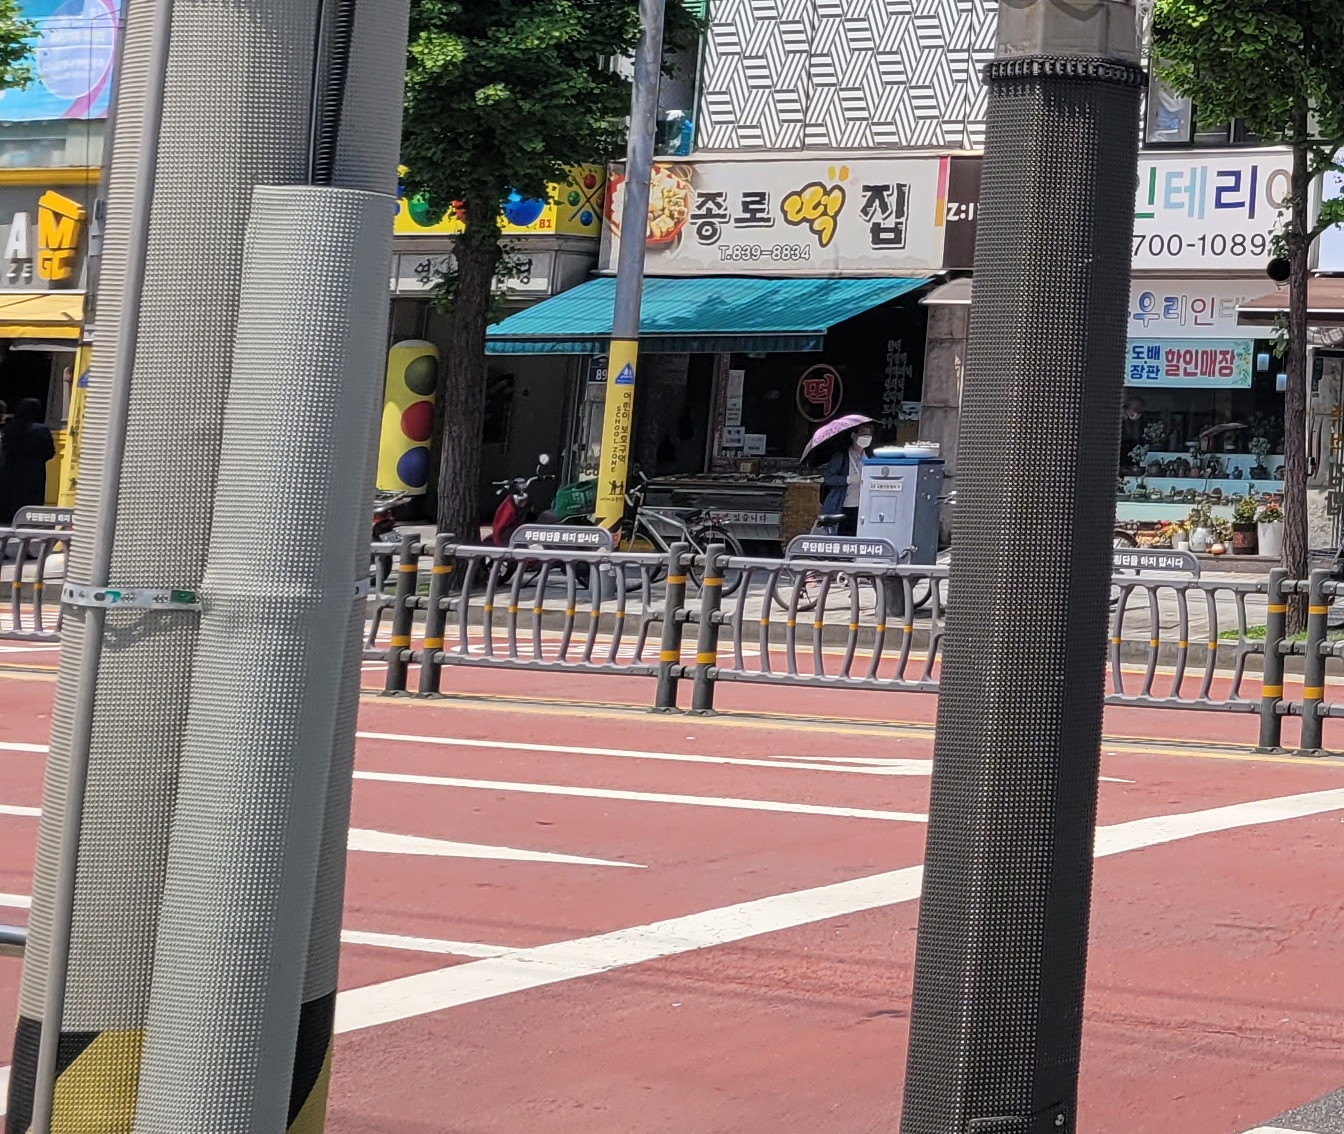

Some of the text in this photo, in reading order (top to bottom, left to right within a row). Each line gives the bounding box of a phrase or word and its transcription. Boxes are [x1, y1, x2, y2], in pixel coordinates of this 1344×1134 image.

[538, 218, 552, 229] B1
[719, 244, 811, 262] T.839-8834
[1131, 345, 1161, 361] 도배
[1130, 348, 1236, 380] 장판 할인매장
[803, 374, 834, 416] 떡
[1140, 556, 1157, 567] 하지
